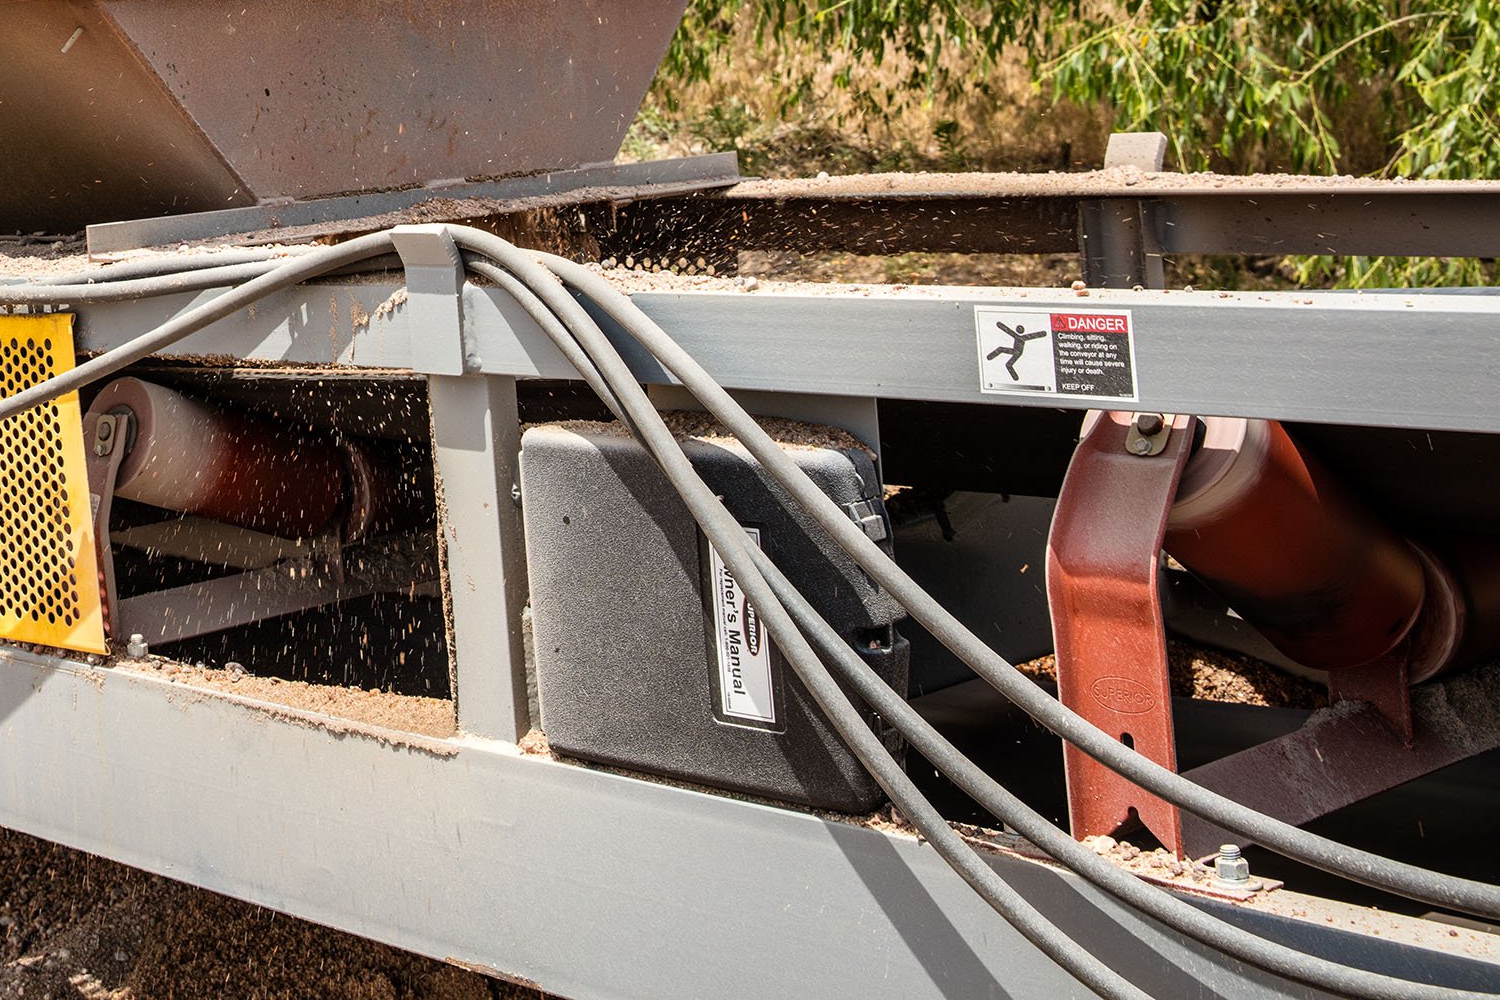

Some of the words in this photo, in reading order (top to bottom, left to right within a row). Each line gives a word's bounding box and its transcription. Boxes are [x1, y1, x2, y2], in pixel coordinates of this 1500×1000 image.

[1068, 317, 1125, 331] DANGER
[1058, 333, 1085, 342] Climbing,
[1058, 342, 1083, 350] walking,
[1091, 343, 1108, 351] riding
[1070, 351, 1097, 359] conveyor
[1061, 366, 1077, 375] injury
[724, 565, 739, 623] wner's
[747, 602, 756, 654] UPERIOR
[728, 629, 746, 695] Manual
